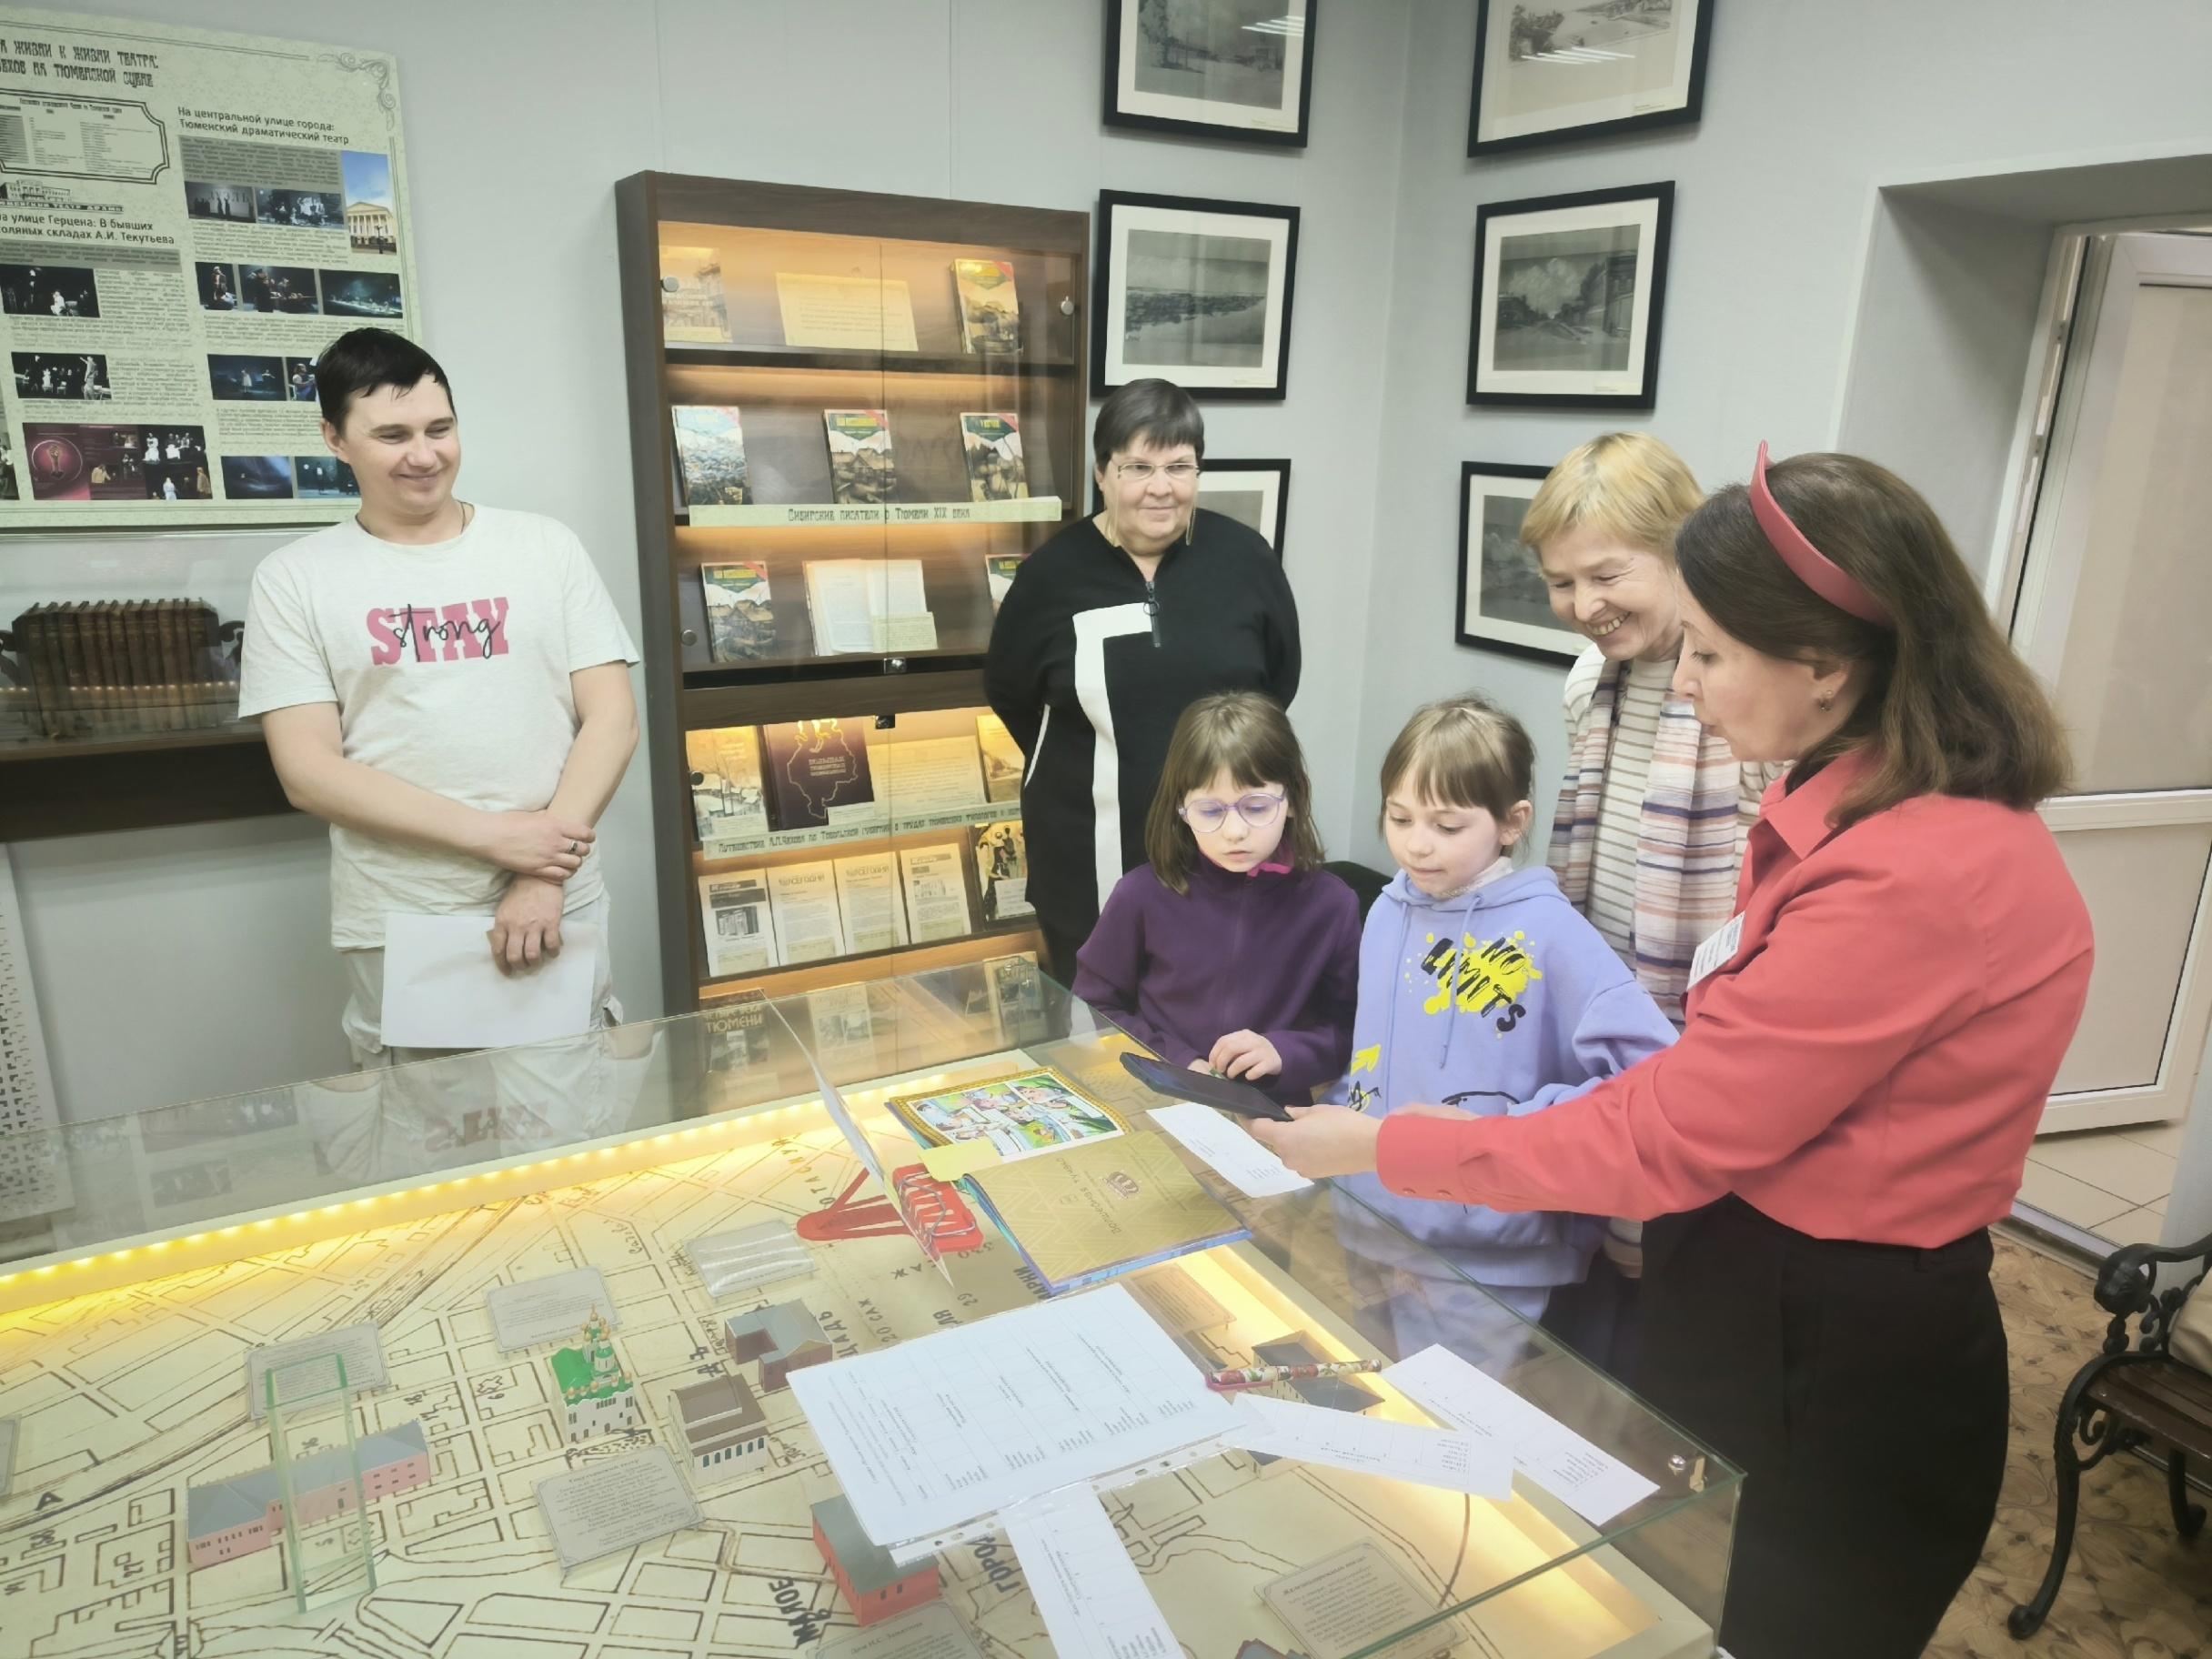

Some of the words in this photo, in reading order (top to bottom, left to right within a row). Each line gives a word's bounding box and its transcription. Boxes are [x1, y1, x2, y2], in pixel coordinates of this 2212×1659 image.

[178, 106, 191, 116] На
[195, 108, 261, 124] центральной
[265, 117, 294, 128] улице
[297, 120, 334, 131] города:
[180, 118, 237, 133] Тюменский
[242, 126, 319, 141] драматический
[323, 135, 349, 146] театр
[12, 215, 45, 225] улице
[48, 216, 96, 227] Герцена:
[100, 218, 106, 227] В
[110, 219, 153, 231] бывших
[46, 227, 91, 239] складах
[121, 232, 175, 245] Текутьева
[367, 597, 508, 665] STAY
[388, 604, 501, 663] strong
[1481, 937, 1525, 975] NO
[706, 1013, 764, 1034] ТЮМЕНИ
[932, 1310, 964, 1327] ЛЯ
